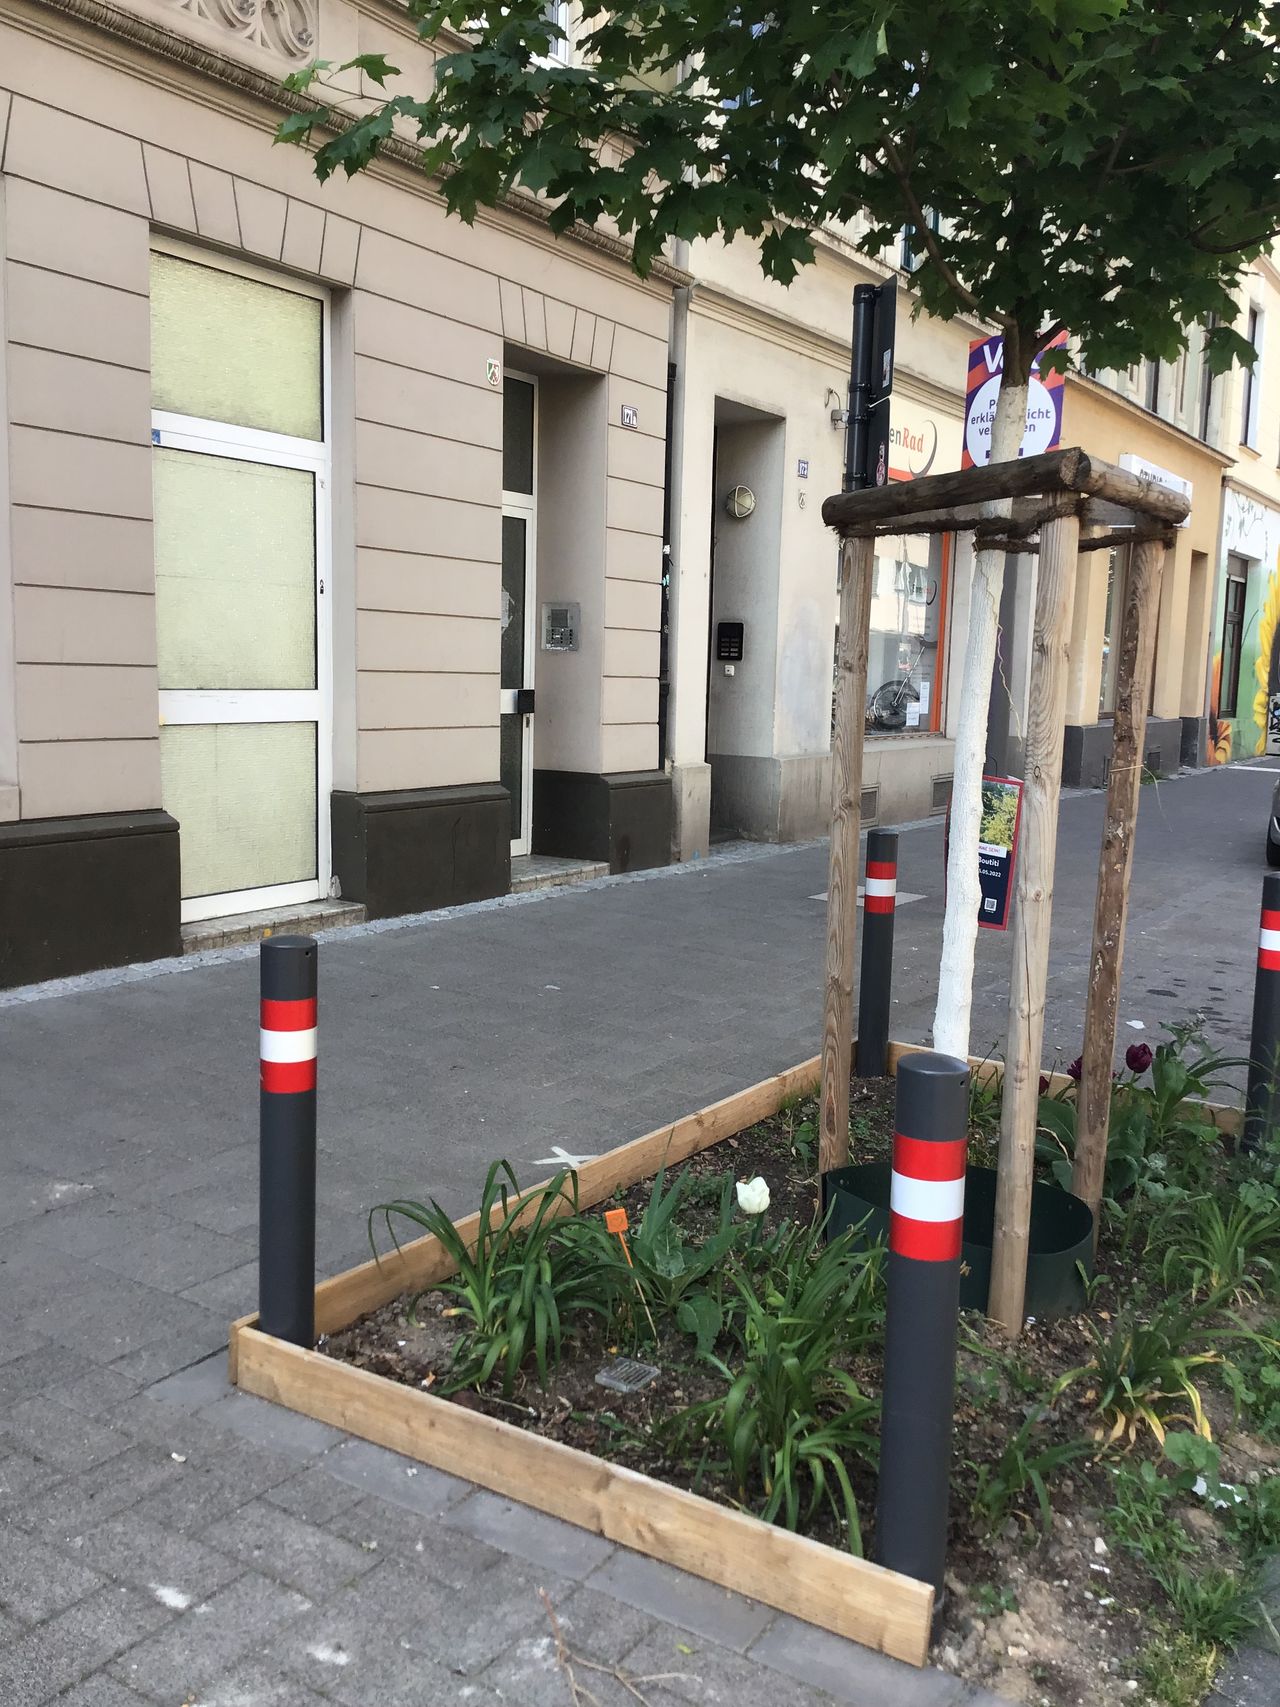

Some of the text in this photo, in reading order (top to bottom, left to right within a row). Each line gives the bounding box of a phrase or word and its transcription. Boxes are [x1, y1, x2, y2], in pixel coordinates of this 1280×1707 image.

[971, 408, 1051, 425] erklä icht
[889, 427, 925, 454] enRad
